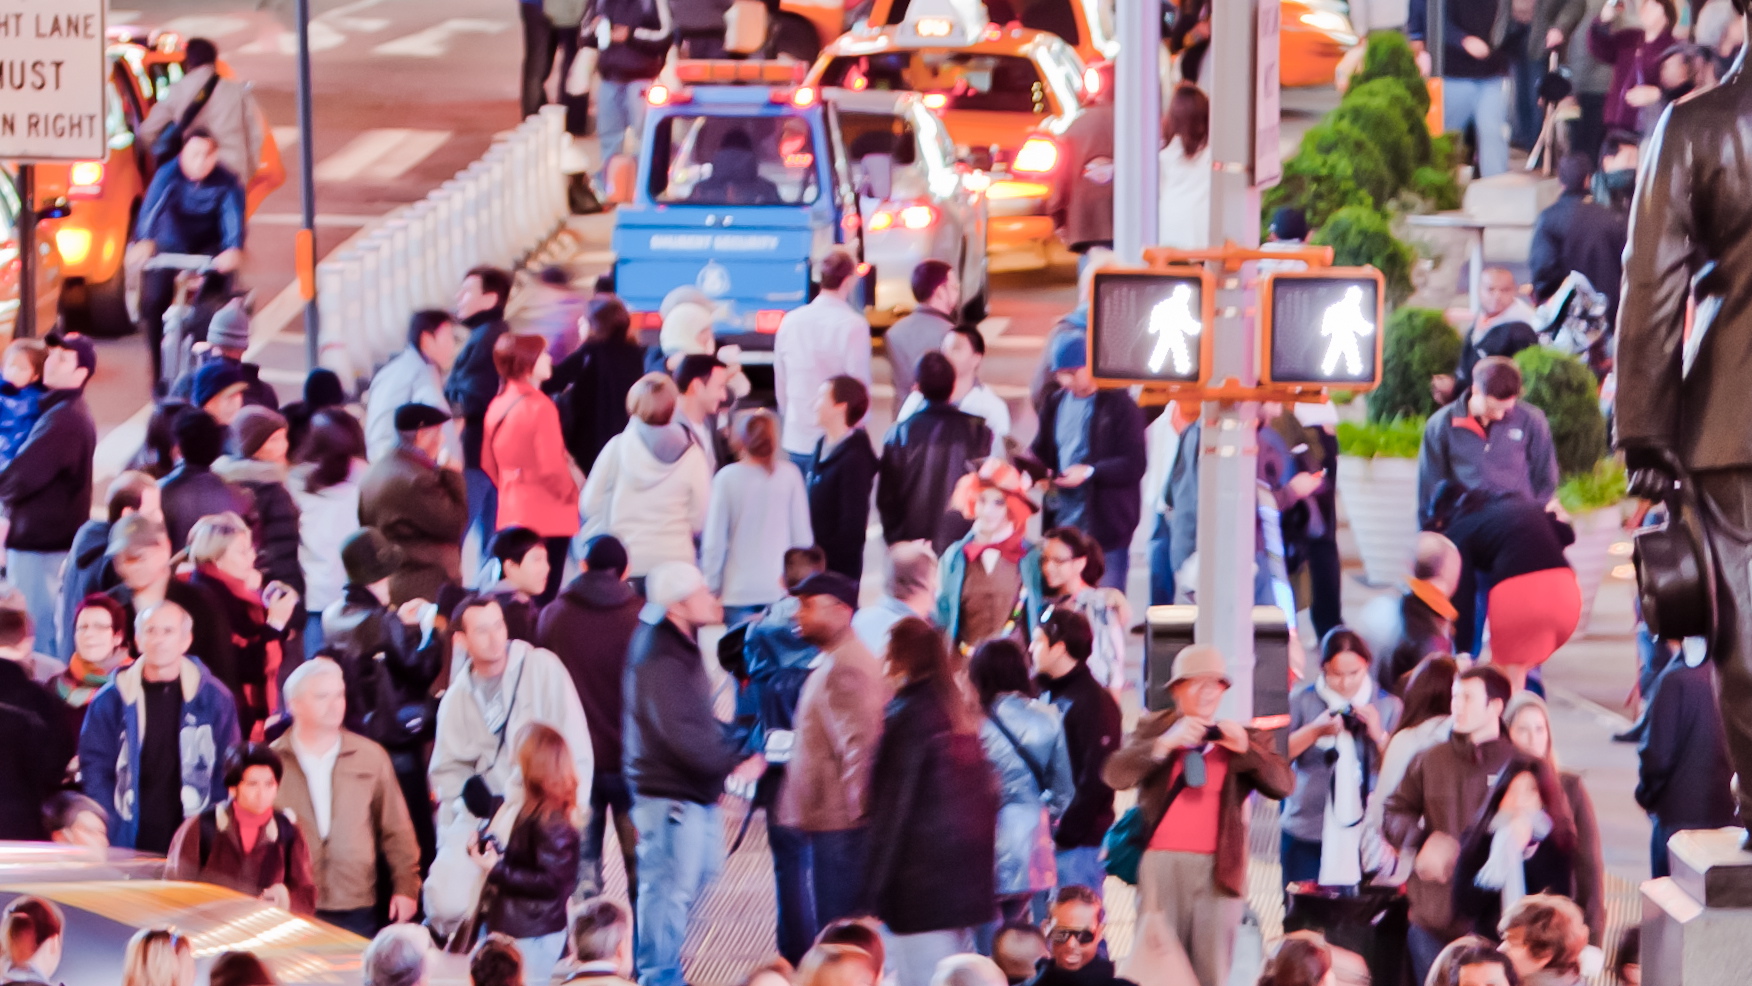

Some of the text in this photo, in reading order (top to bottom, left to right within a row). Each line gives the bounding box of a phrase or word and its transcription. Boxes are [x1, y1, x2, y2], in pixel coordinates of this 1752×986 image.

[35, 13, 96, 39] LANE
[0, 60, 64, 90] UST
[27, 113, 97, 139] RIGHT
